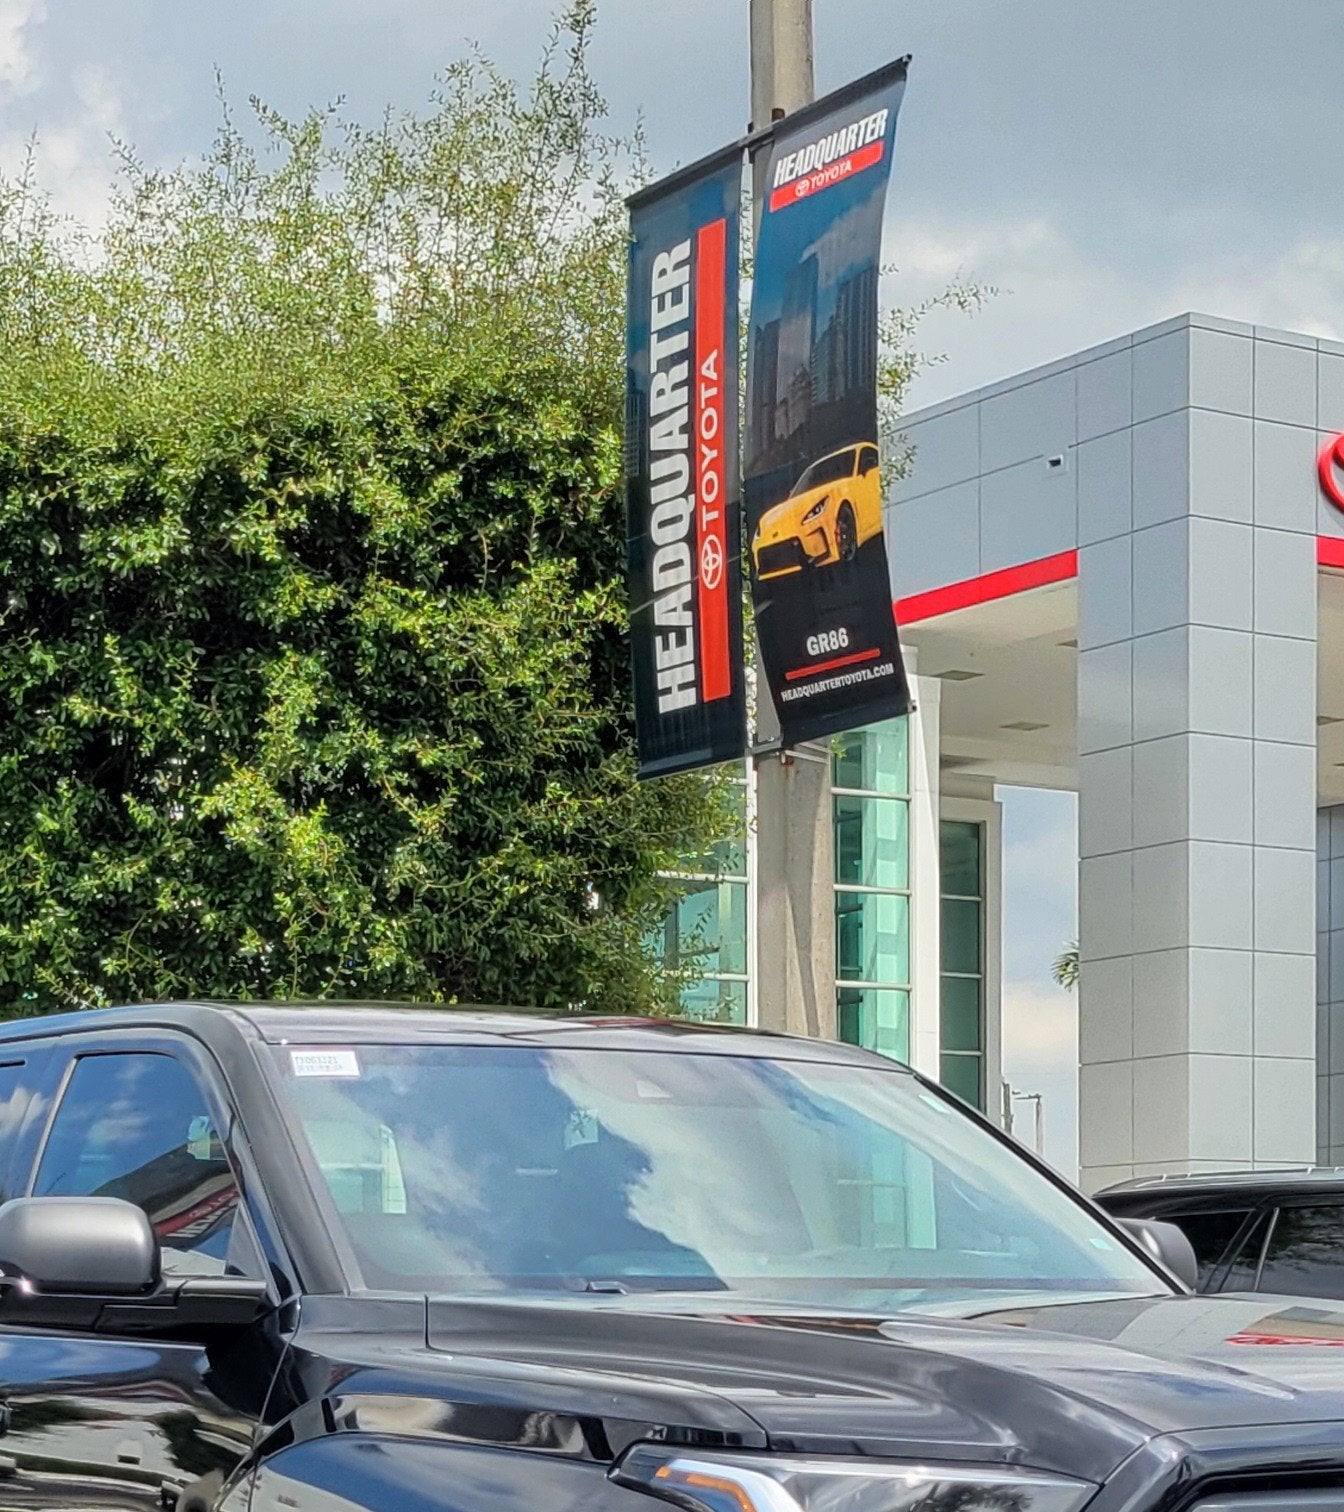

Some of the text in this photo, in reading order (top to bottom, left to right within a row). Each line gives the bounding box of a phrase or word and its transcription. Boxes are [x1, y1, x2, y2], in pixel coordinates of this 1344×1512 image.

[773, 108, 889, 188] HEADQUARTER
[811, 160, 853, 189] TOYOTA
[700, 348, 719, 532] TOYOTA
[649, 238, 697, 714] HEADQUARTER
[806, 627, 849, 656] GR86
[780, 662, 895, 702] HEADQUARTERTOYOTA.COM
